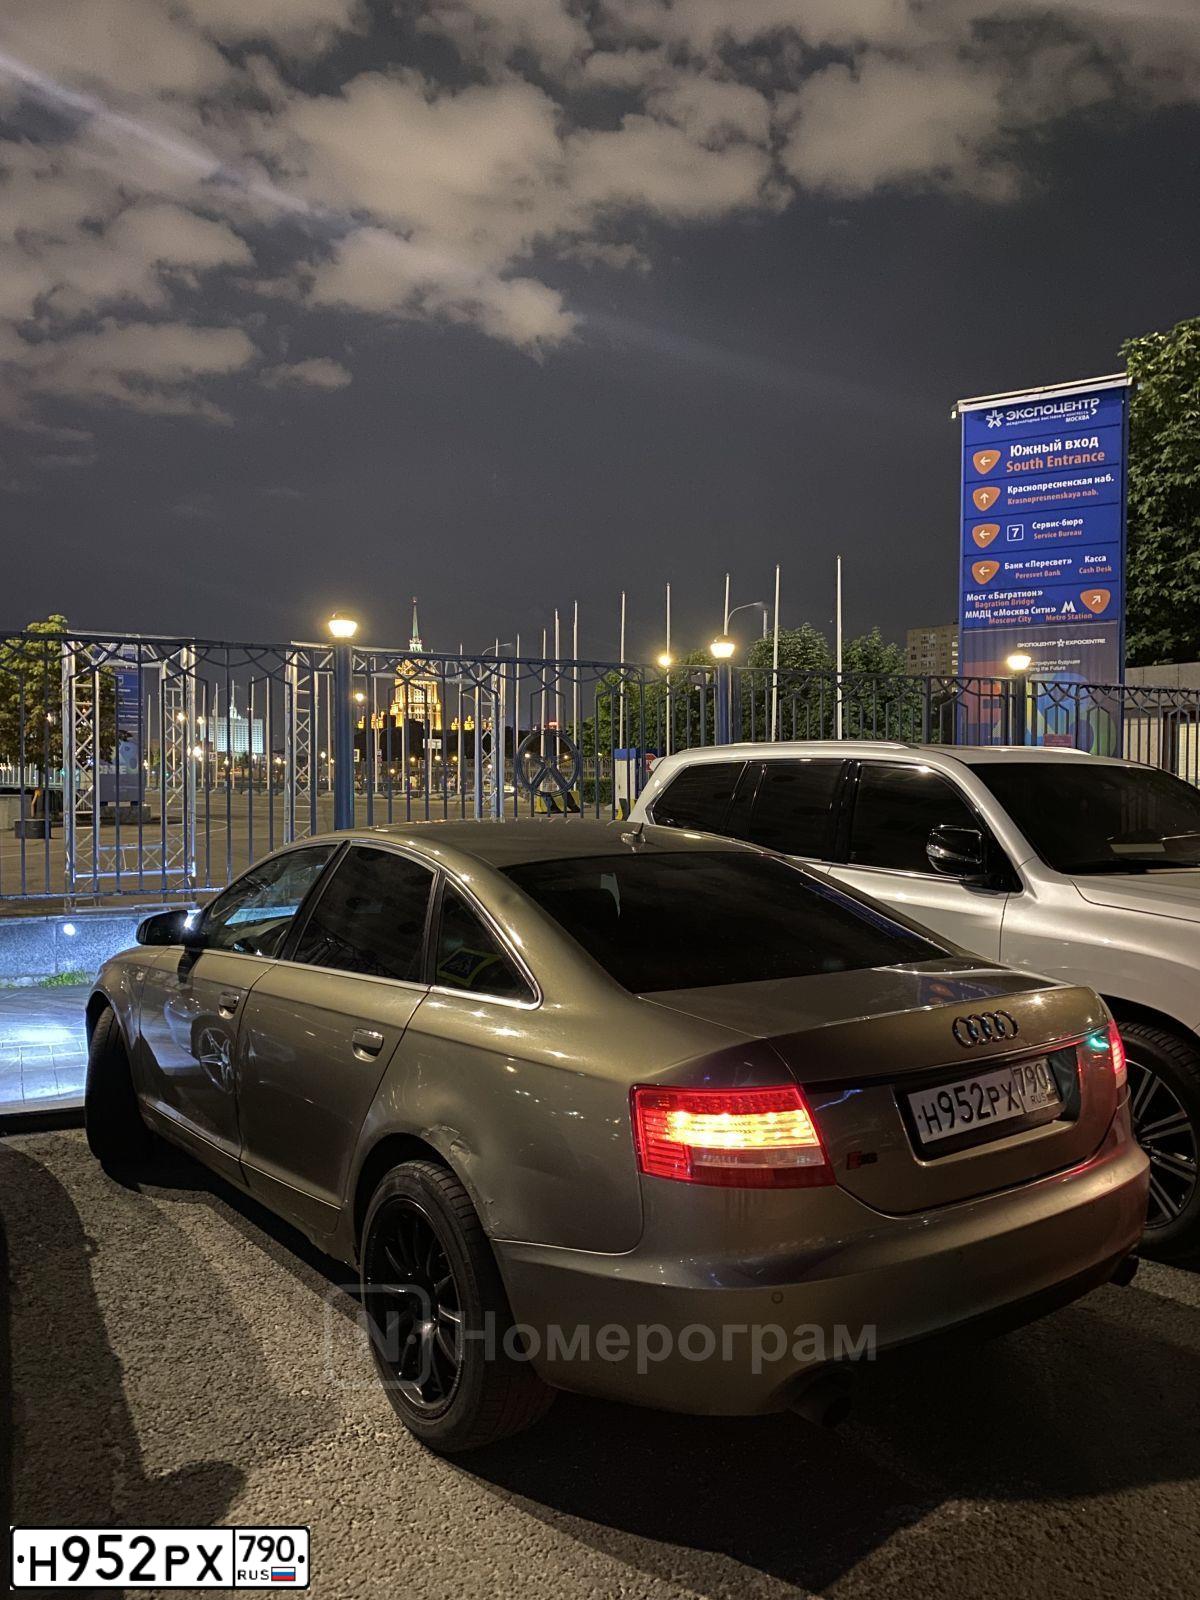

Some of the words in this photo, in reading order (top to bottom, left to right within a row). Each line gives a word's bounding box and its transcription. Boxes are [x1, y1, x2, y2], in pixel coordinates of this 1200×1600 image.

[1006, 398, 1100, 420] ЭКСПОЦЕНТР
[1065, 414, 1090, 423] МОСКВА
[1010, 439, 1062, 457] Южный
[1065, 436, 1099, 450] вход
[1006, 458, 1043, 472] South
[1046, 451, 1105, 467] Entrance
[1007, 477, 1092, 494] Краснопресненская
[1094, 473, 1114, 483] наб.
[1007, 491, 1081, 505] Krasnopresnenskaya
[1082, 489, 1099, 497] nab.
[1032, 518, 1084, 530] Сервис-бюро
[1011, 528, 1020, 538] 7
[1033, 531, 1057, 540] Service
[1058, 530, 1082, 538] Bureau
[1004, 562, 1023, 570] Банк
[1025, 558, 1072, 569] «Пересвет»
[1084, 555, 1107, 563] Касса
[1015, 571, 1043, 579] Peresvet
[1044, 569, 1061, 577] Bank
[1095, 565, 1112, 573] Desk
[966, 593, 986, 602] Мост
[988, 590, 1043, 600] «Багратион»
[975, 600, 1010, 609] Bagration
[1011, 598, 1035, 607] Bridge
[965, 609, 991, 619] ММДЦ
[993, 607, 1030, 617] «Москва
[1030, 606, 1057, 615] Сити»
[1045, 613, 1067, 622] Metro
[1067, 612, 1093, 621] Station
[988, 616, 1016, 625] Moscow
[1017, 616, 1032, 624] City
[1065, 638, 1106, 646] EXPOCENTRE
[1013, 1063, 1048, 1097] 790
[1030, 1091, 1047, 1104] RUS
